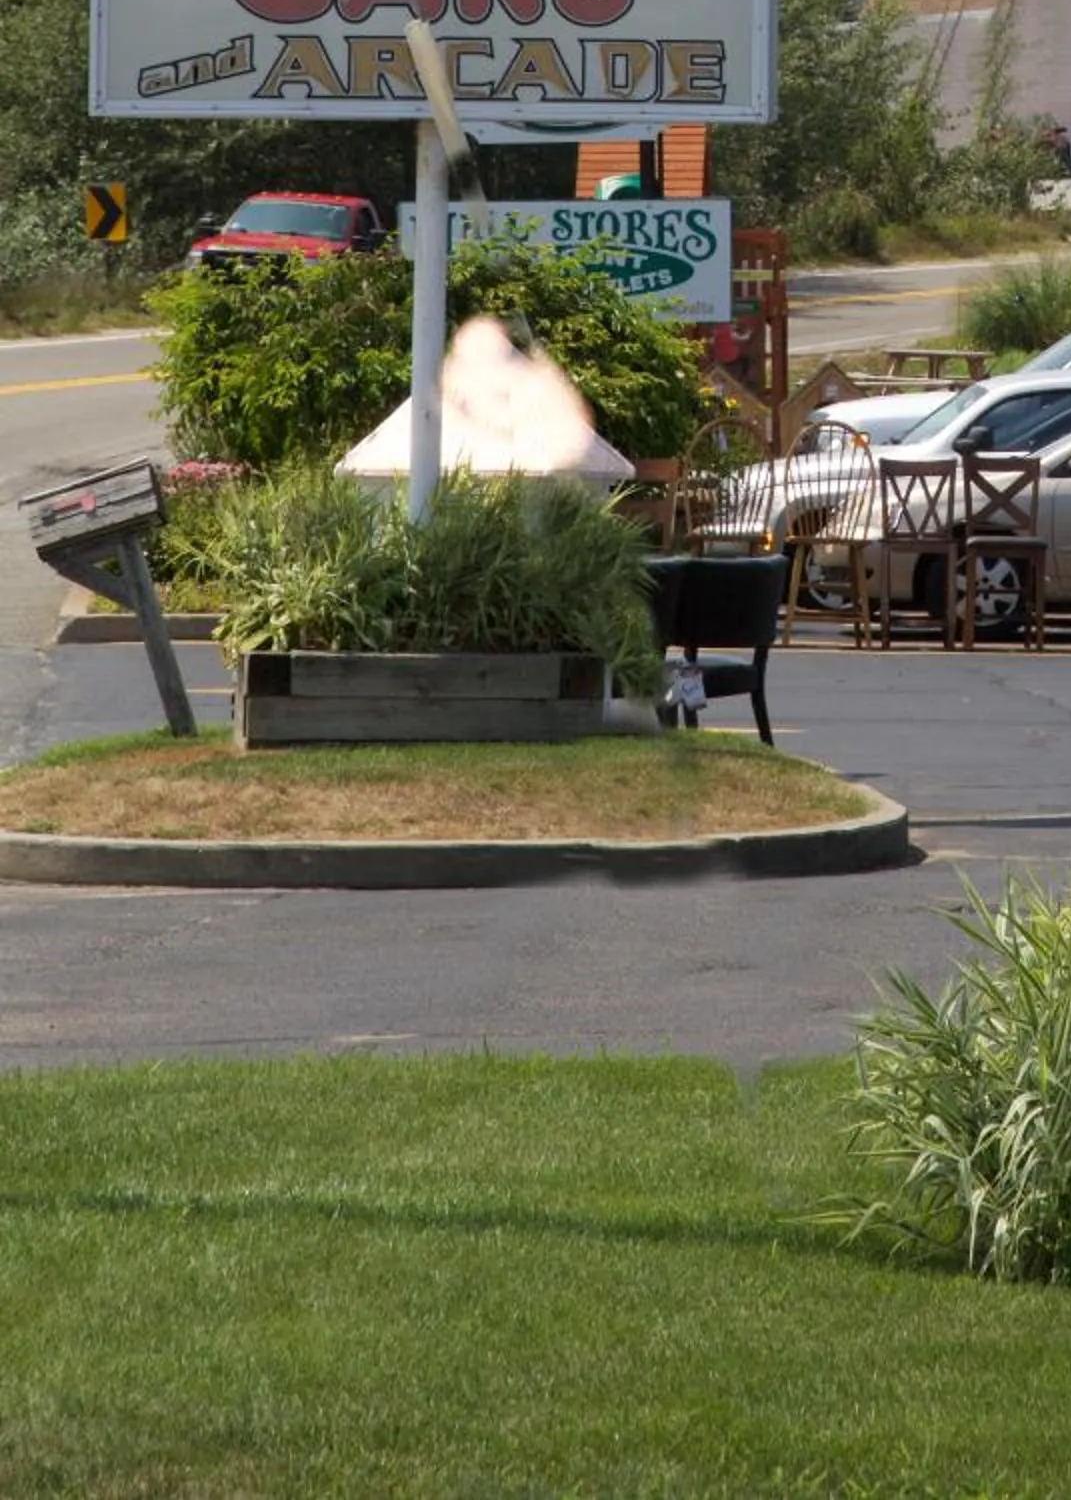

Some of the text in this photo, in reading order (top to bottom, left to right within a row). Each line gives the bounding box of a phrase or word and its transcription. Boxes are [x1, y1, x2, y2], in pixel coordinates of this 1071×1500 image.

[138, 34, 726, 102] and ARCADE
[552, 209, 717, 262] STORES
